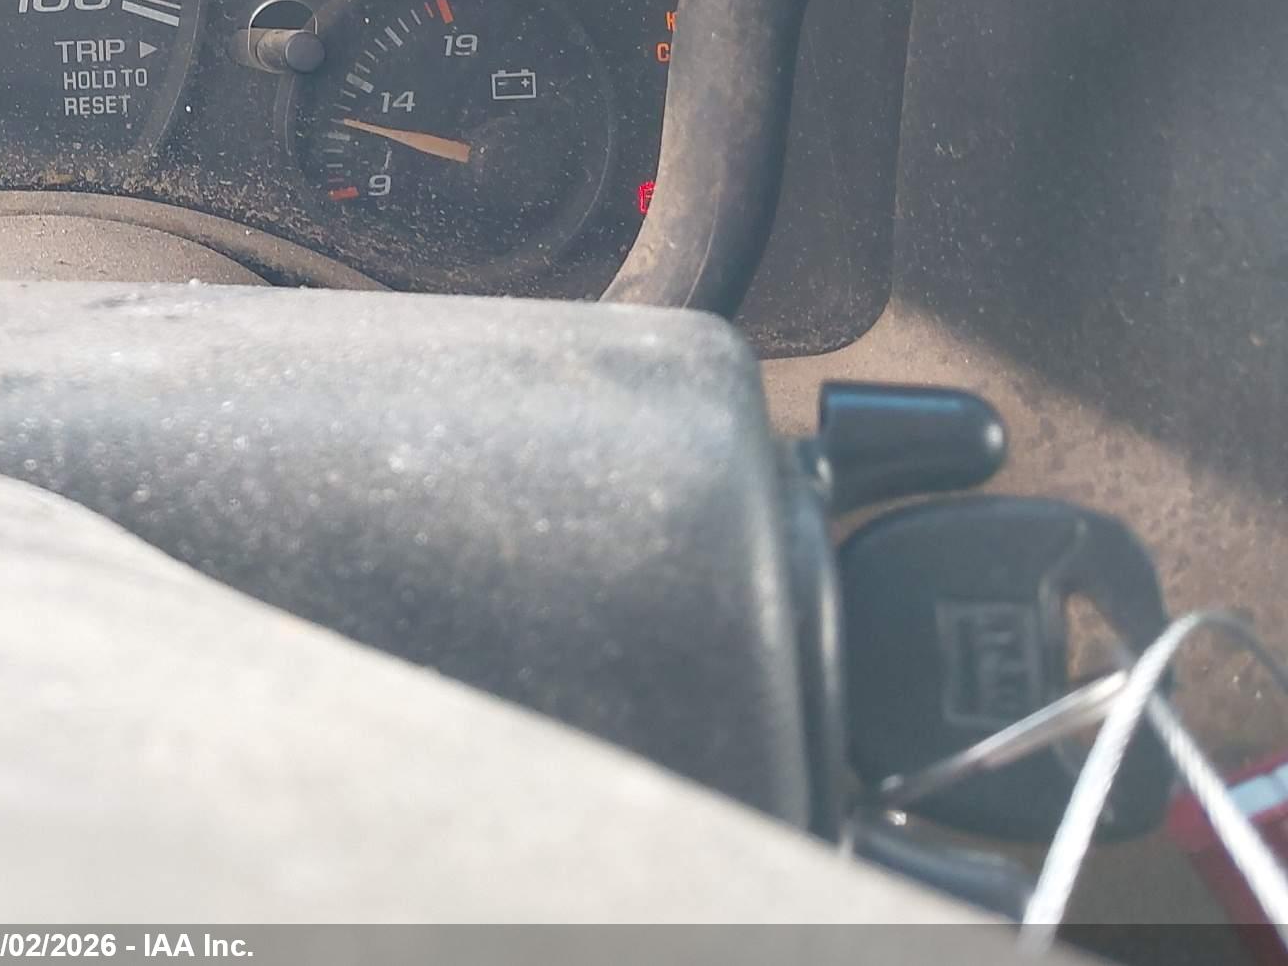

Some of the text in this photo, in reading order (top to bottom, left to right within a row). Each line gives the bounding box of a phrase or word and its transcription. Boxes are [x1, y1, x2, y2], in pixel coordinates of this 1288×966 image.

[54, 39, 126, 64] TRIP
[444, 34, 478, 56] 19
[63, 68, 149, 91] HOLD TO
[63, 95, 131, 117] RESET
[380, 91, 416, 113] 14
[368, 174, 392, 196] 9
